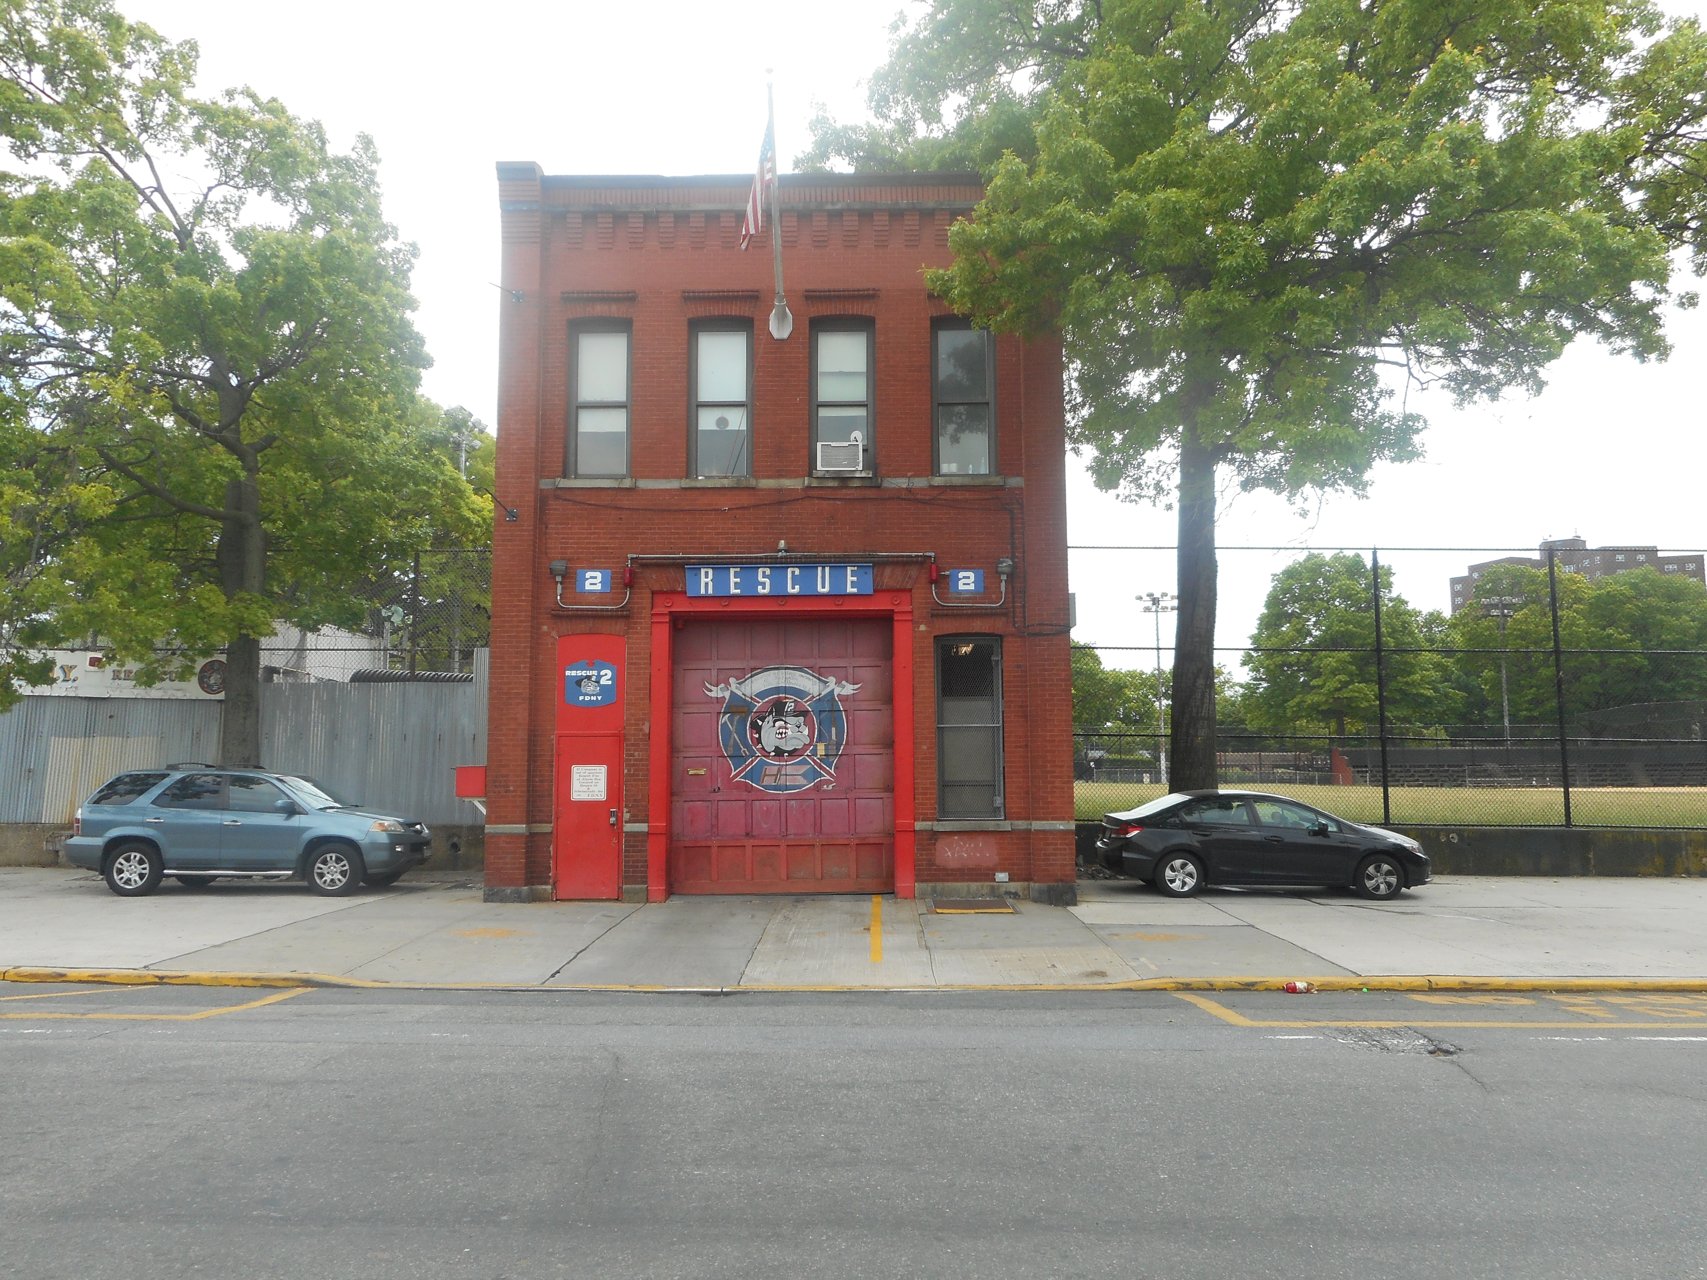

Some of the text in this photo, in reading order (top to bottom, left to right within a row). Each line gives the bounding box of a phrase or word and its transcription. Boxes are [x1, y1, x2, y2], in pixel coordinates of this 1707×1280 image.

[585, 571, 602, 590] 2
[700, 566, 858, 595] RESCUE
[958, 571, 975, 590] 2
[599, 669, 612, 685] 2
